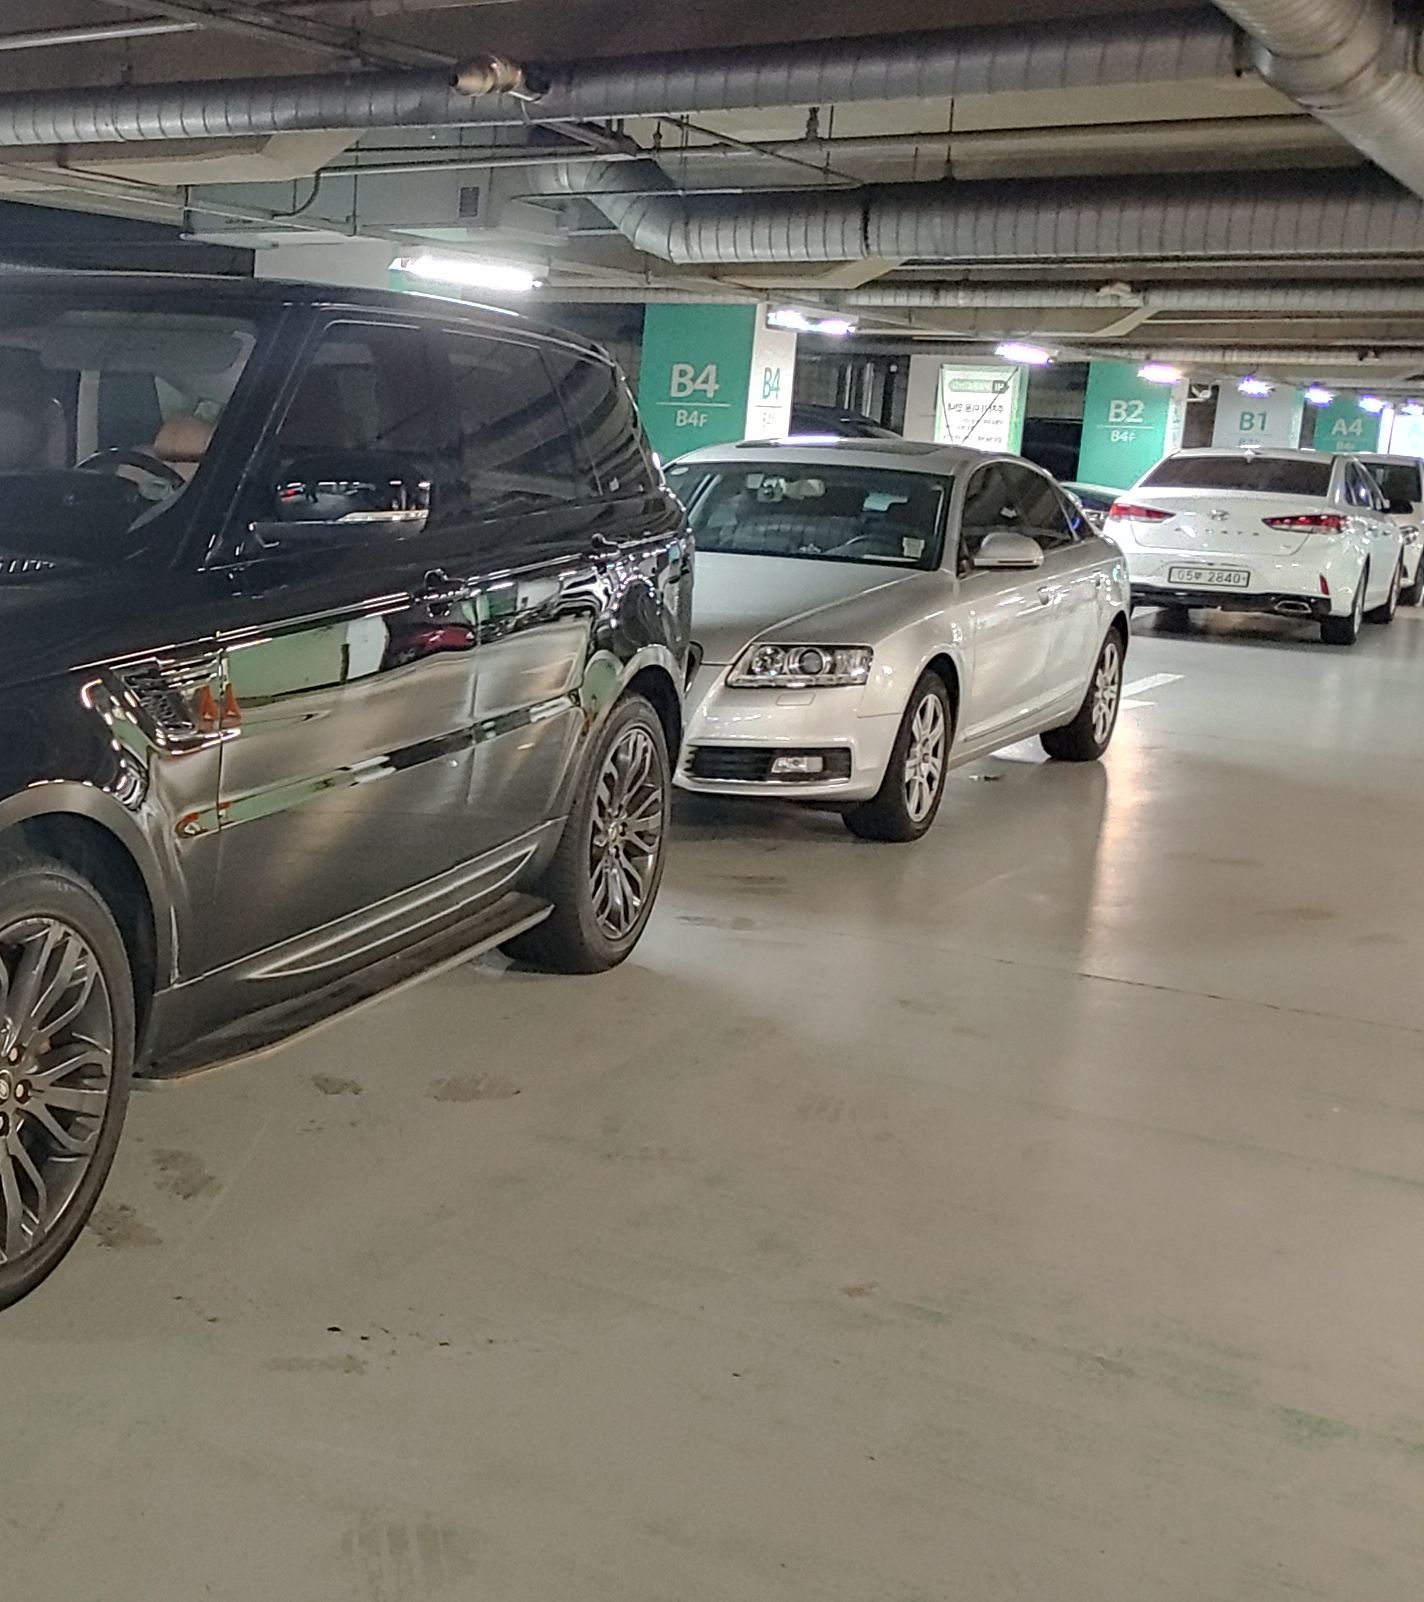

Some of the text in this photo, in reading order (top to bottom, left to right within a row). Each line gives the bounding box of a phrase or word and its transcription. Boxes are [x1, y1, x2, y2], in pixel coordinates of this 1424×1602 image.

[670, 363, 720, 399] B4
[762, 366, 781, 400] B4
[676, 409, 709, 428] B4F
[1107, 398, 1146, 423] B2
[1238, 411, 1267, 432] B1
[1331, 418, 1364, 436] A4
[1207, 572, 1241, 584] 2840
